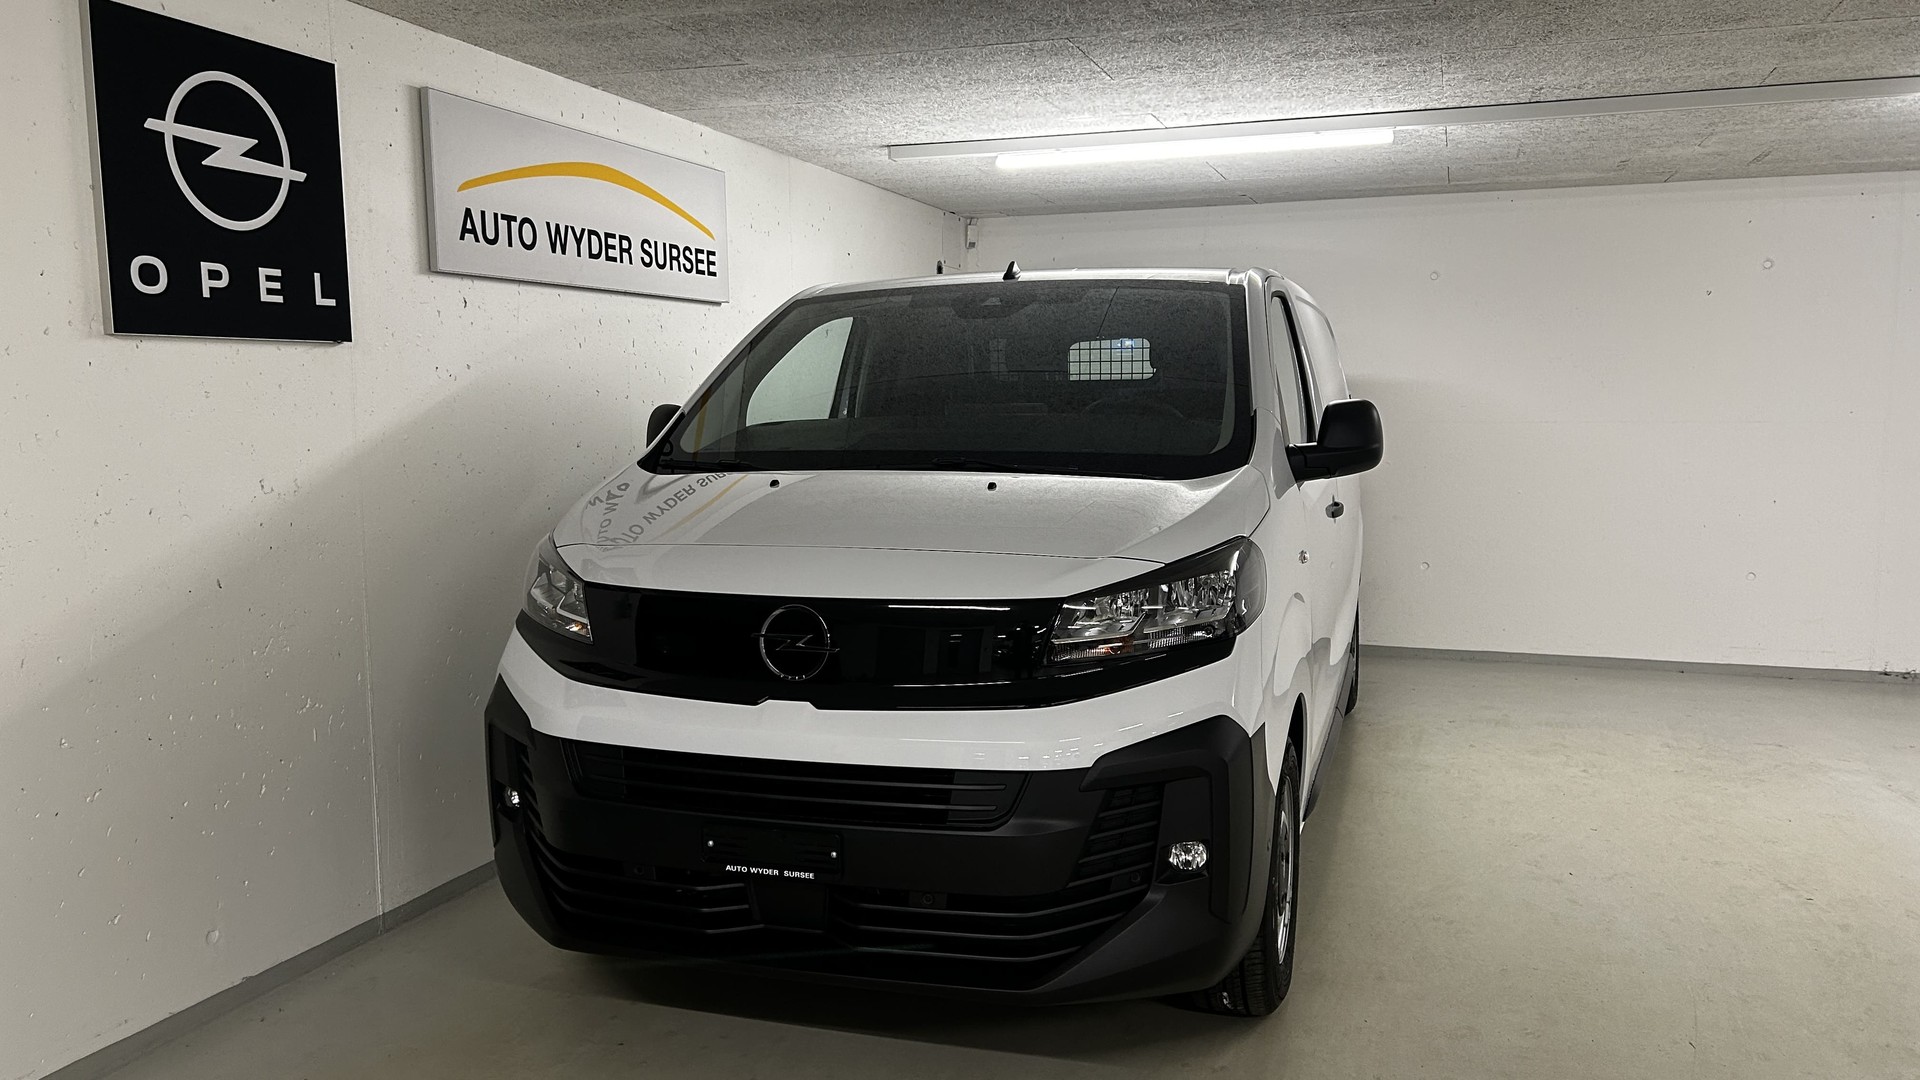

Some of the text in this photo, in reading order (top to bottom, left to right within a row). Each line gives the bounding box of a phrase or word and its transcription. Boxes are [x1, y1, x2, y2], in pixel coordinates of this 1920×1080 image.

[459, 207, 718, 278] AUTO WYDER SURSEE
[129, 254, 337, 307] OPEL
[725, 864, 815, 880] AUTO WYDER SURSEE
